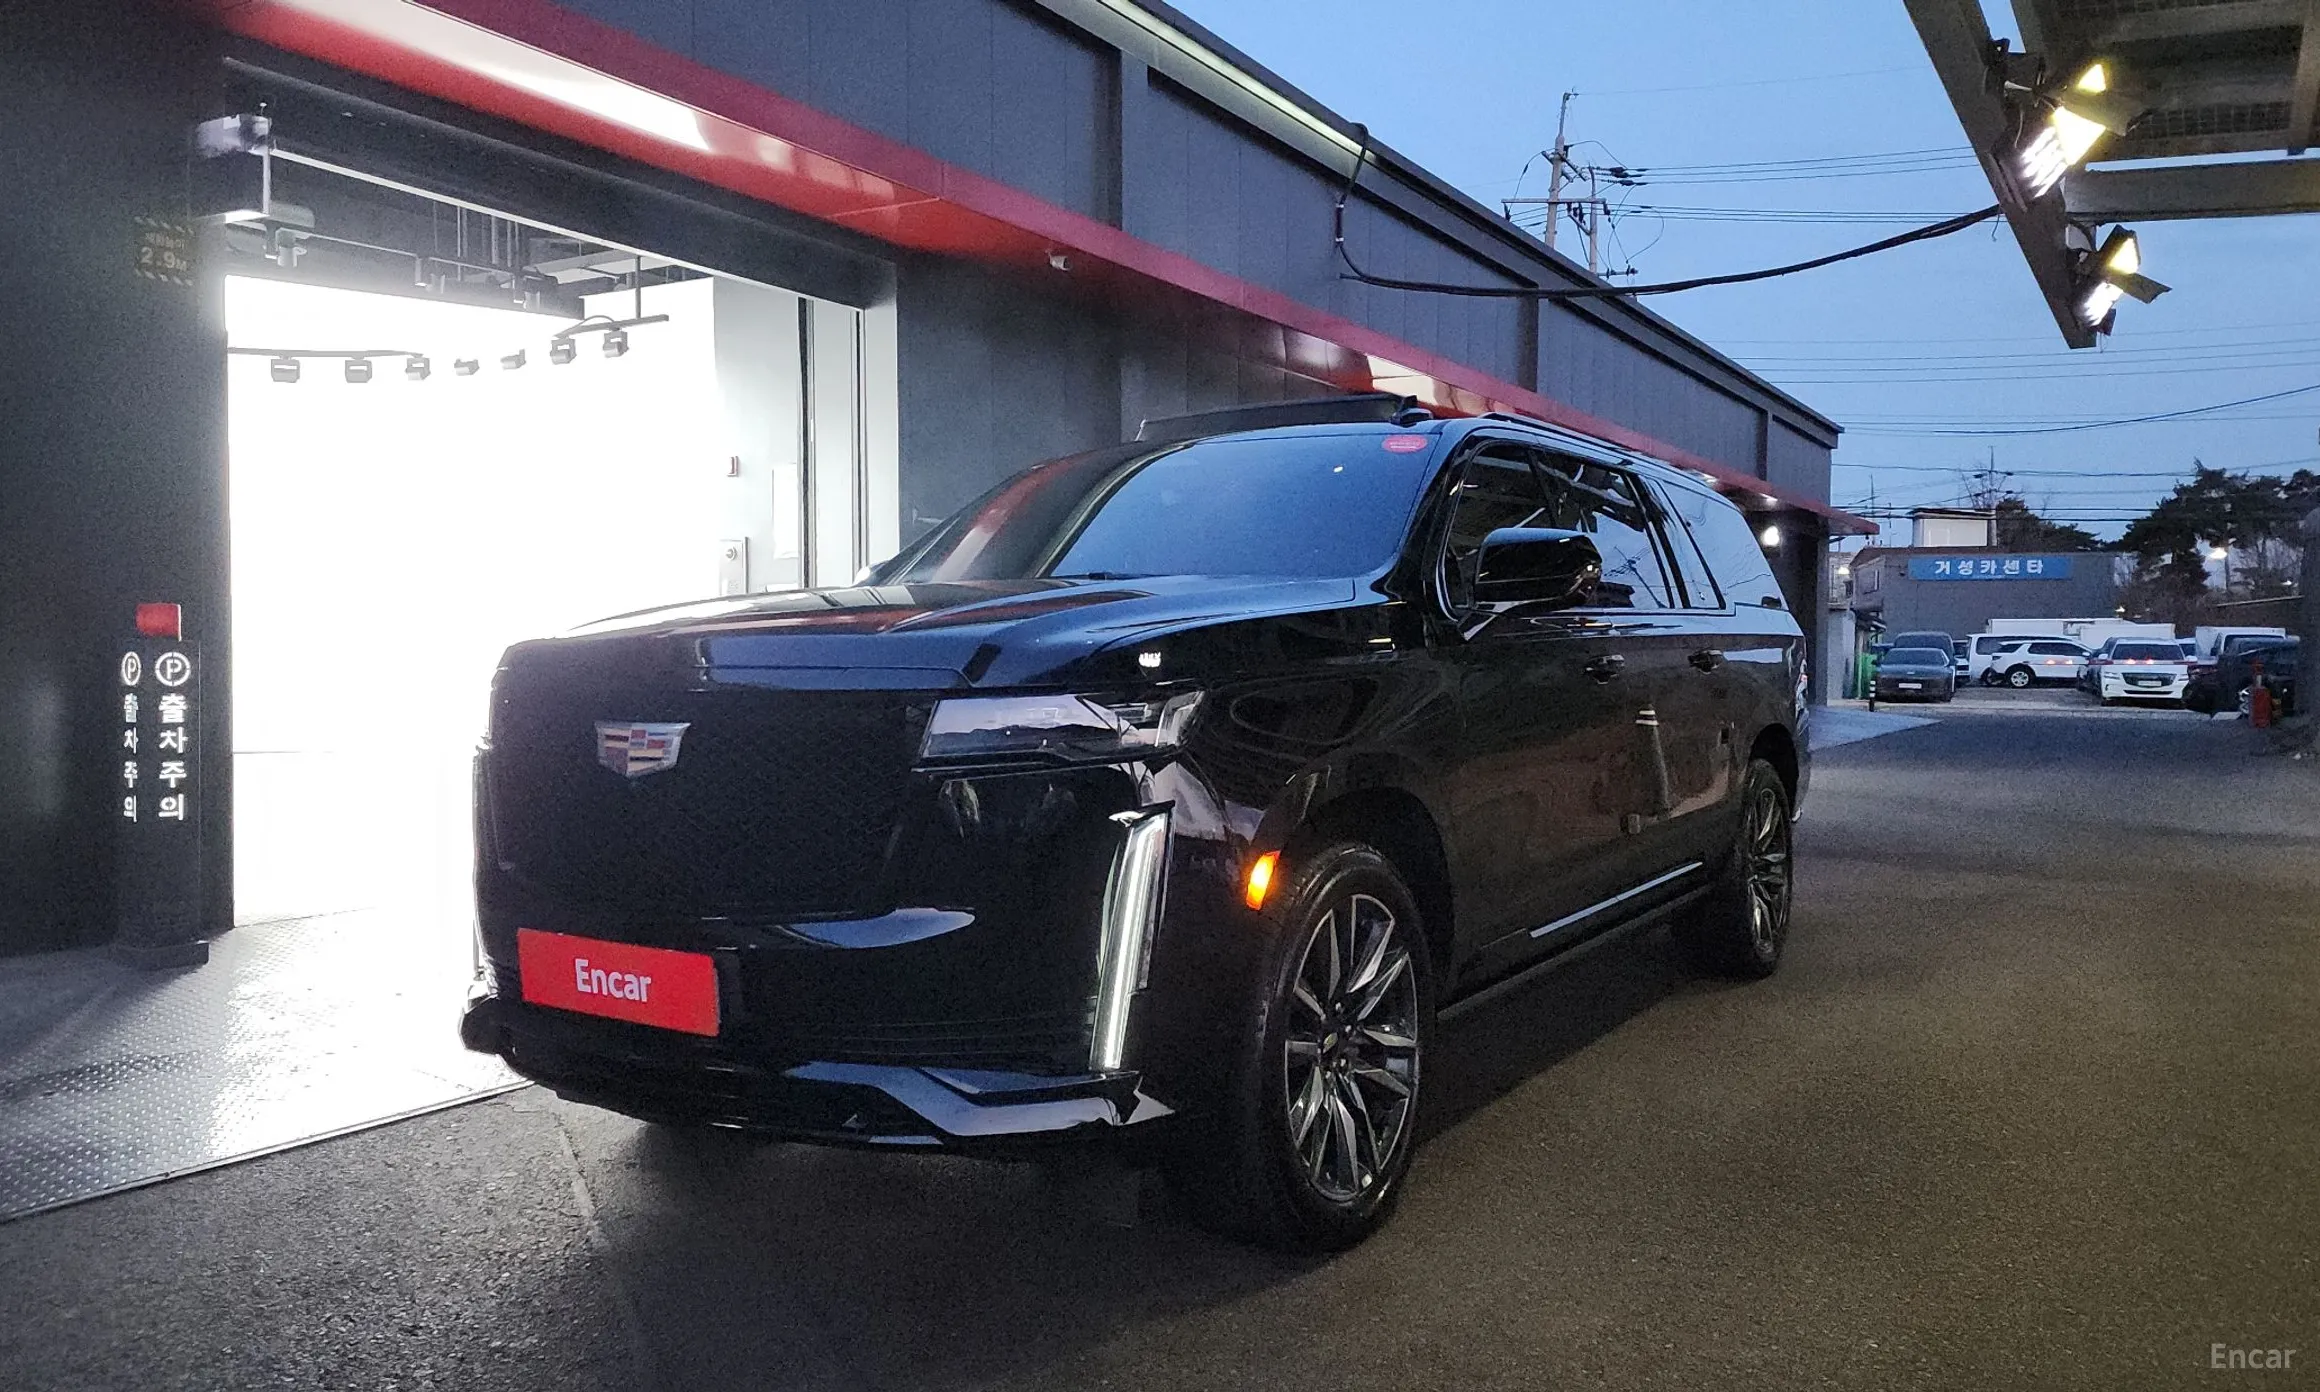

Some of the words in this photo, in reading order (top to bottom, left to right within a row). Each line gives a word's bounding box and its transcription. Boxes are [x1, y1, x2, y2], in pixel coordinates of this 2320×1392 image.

[1934, 559, 2044, 575] 거성카센타
[123, 693, 139, 822] 출차주의
[158, 693, 188, 821] 출차주의
[575, 958, 653, 1002] Encar
